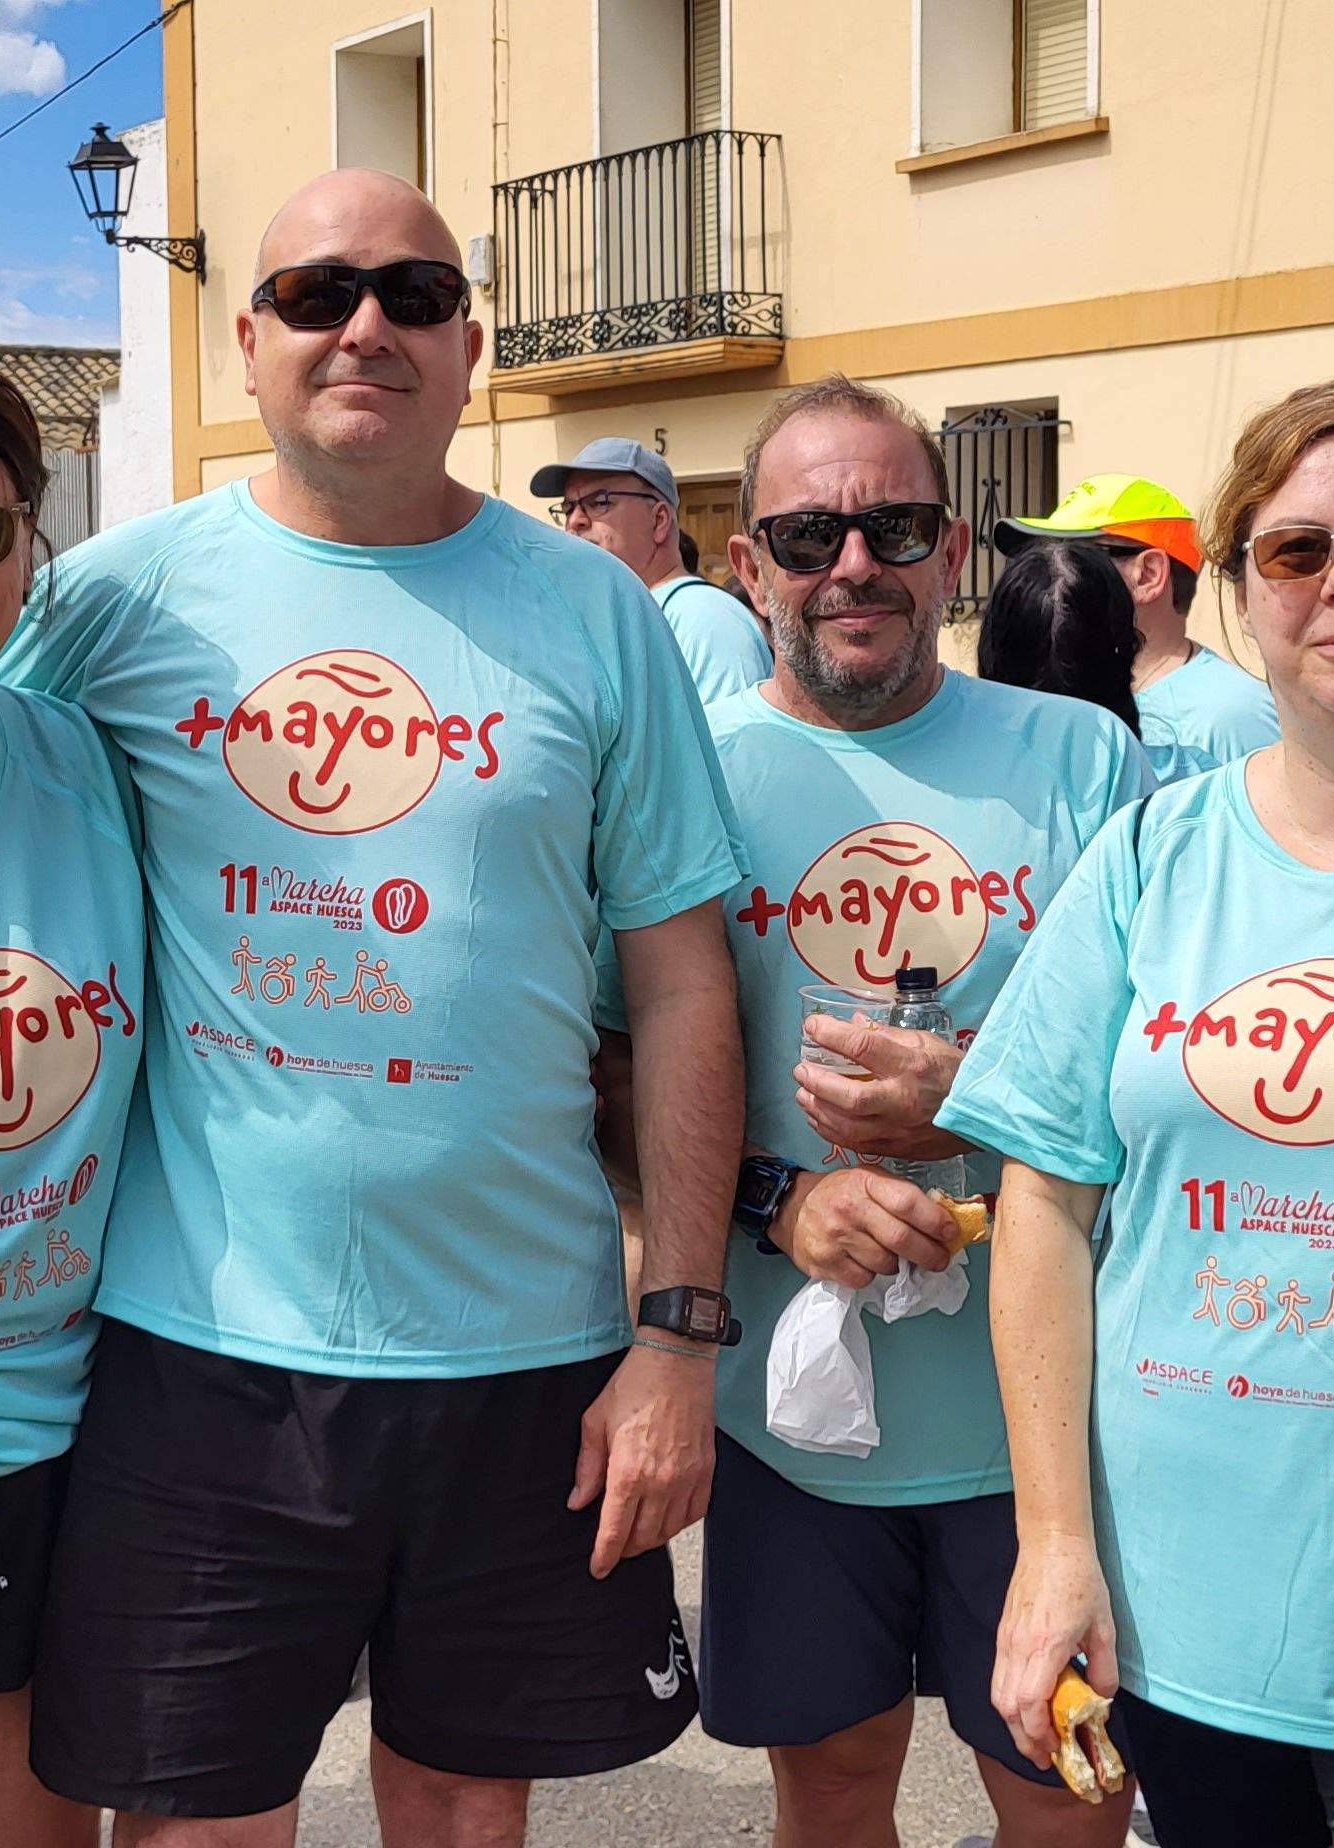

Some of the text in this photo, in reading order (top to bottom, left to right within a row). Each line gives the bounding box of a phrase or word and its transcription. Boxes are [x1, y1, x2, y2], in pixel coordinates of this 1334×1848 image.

[655, 428, 666, 455] 5
[271, 866, 366, 905] Marcha
[270, 900, 362, 919] ASPACE HUESCA
[333, 920, 362, 930] 2023
[287, 1053, 314, 1067] hoya
[317, 1057, 330, 1067] de
[332, 1059, 373, 1072] huesca
[416, 1060, 474, 1073] Ayuntamiento
[427, 1073, 460, 1082] Huesca
[1240, 1218, 1286, 1233] ASPACE
[1253, 1383, 1283, 1397] hoya
[1286, 1386, 1300, 1399] de
